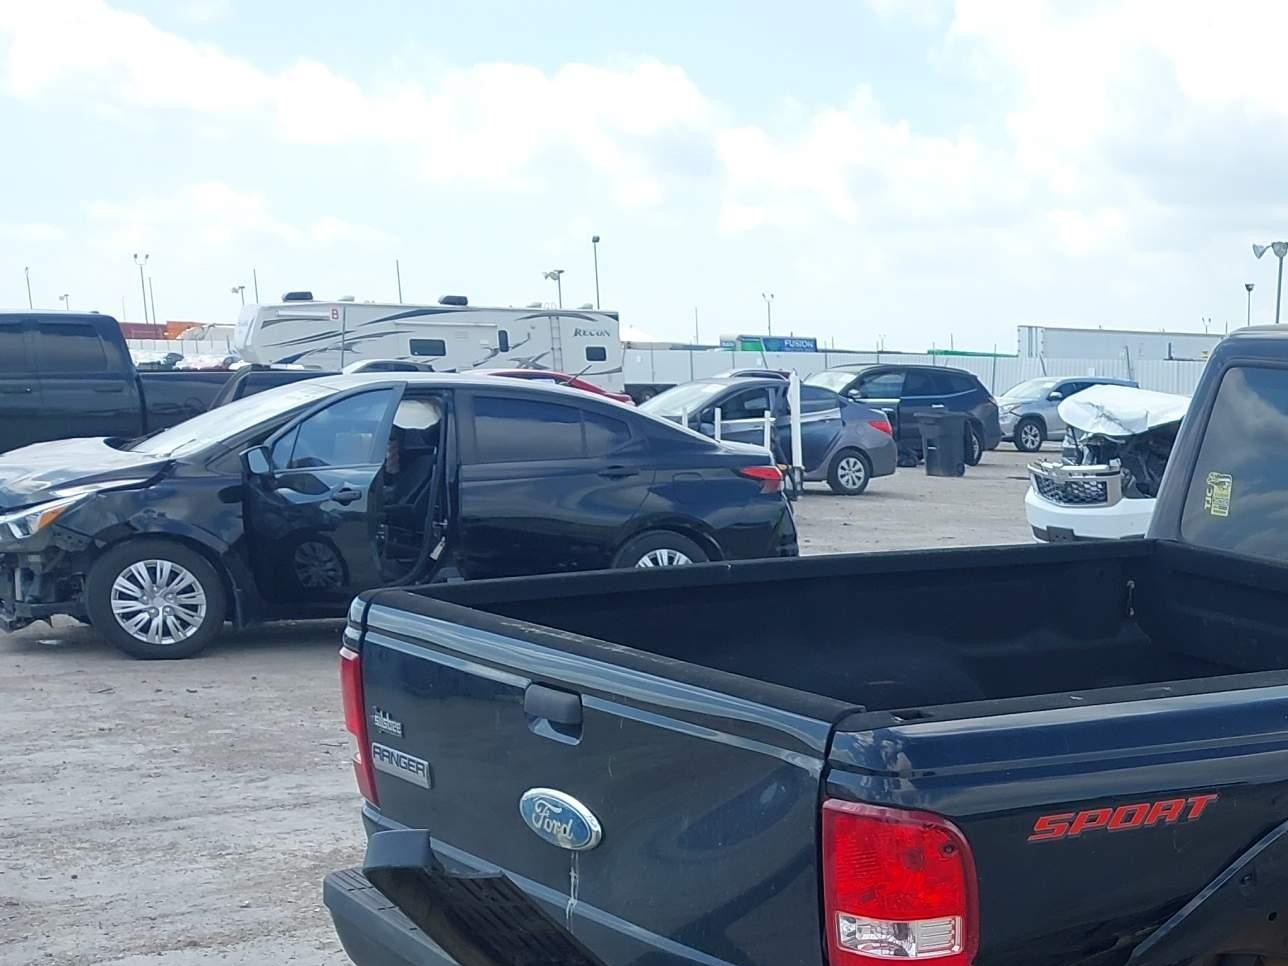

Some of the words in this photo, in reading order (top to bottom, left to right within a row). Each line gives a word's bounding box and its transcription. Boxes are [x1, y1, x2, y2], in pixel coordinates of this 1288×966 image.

[372, 745, 427, 777] RANGER
[532, 799, 574, 840] Ford
[1027, 793, 1218, 843] SPORT
